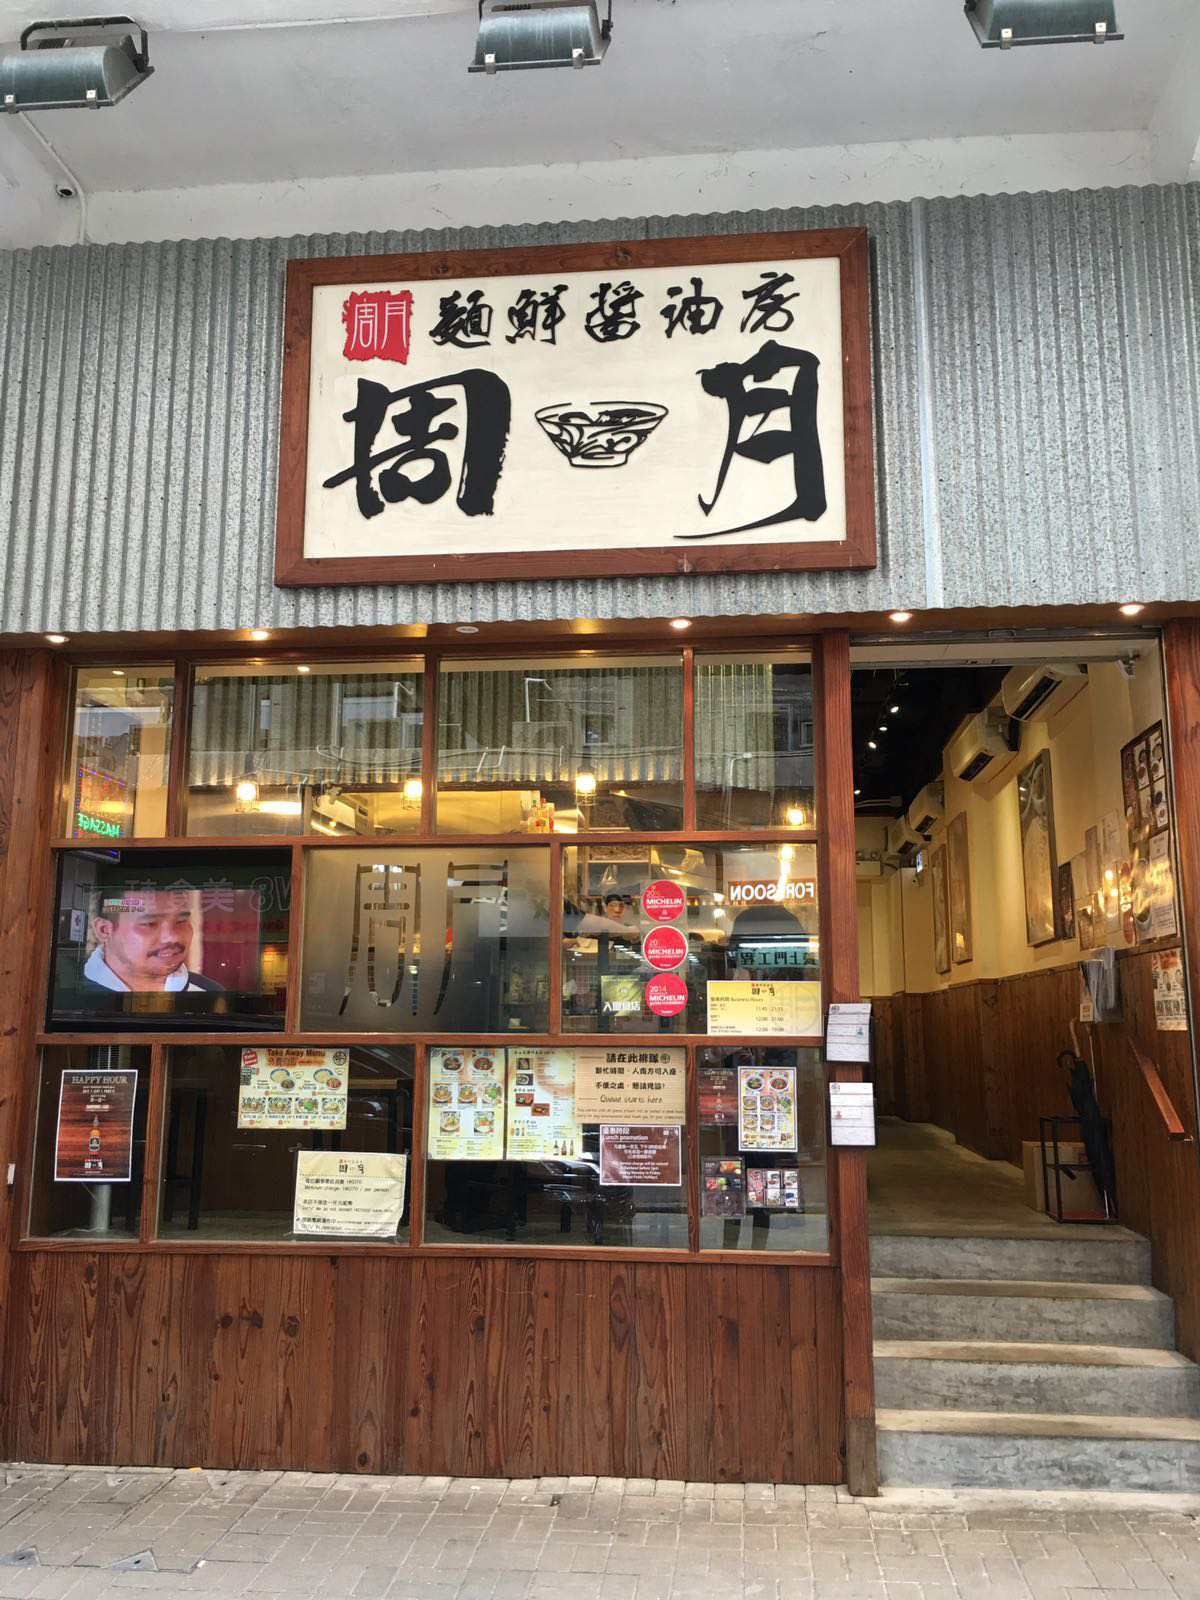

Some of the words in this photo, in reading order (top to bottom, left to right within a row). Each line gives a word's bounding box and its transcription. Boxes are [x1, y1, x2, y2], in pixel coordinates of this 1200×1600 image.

[674, 340, 828, 539] 月
[285, 1050, 304, 1058] Away
[72, 1076, 102, 1084] HAPPY
[103, 1076, 128, 1084] HOUR
[600, 1095, 622, 1104] Queue
[624, 1096, 645, 1104] starts
[647, 1095, 663, 1104] here
